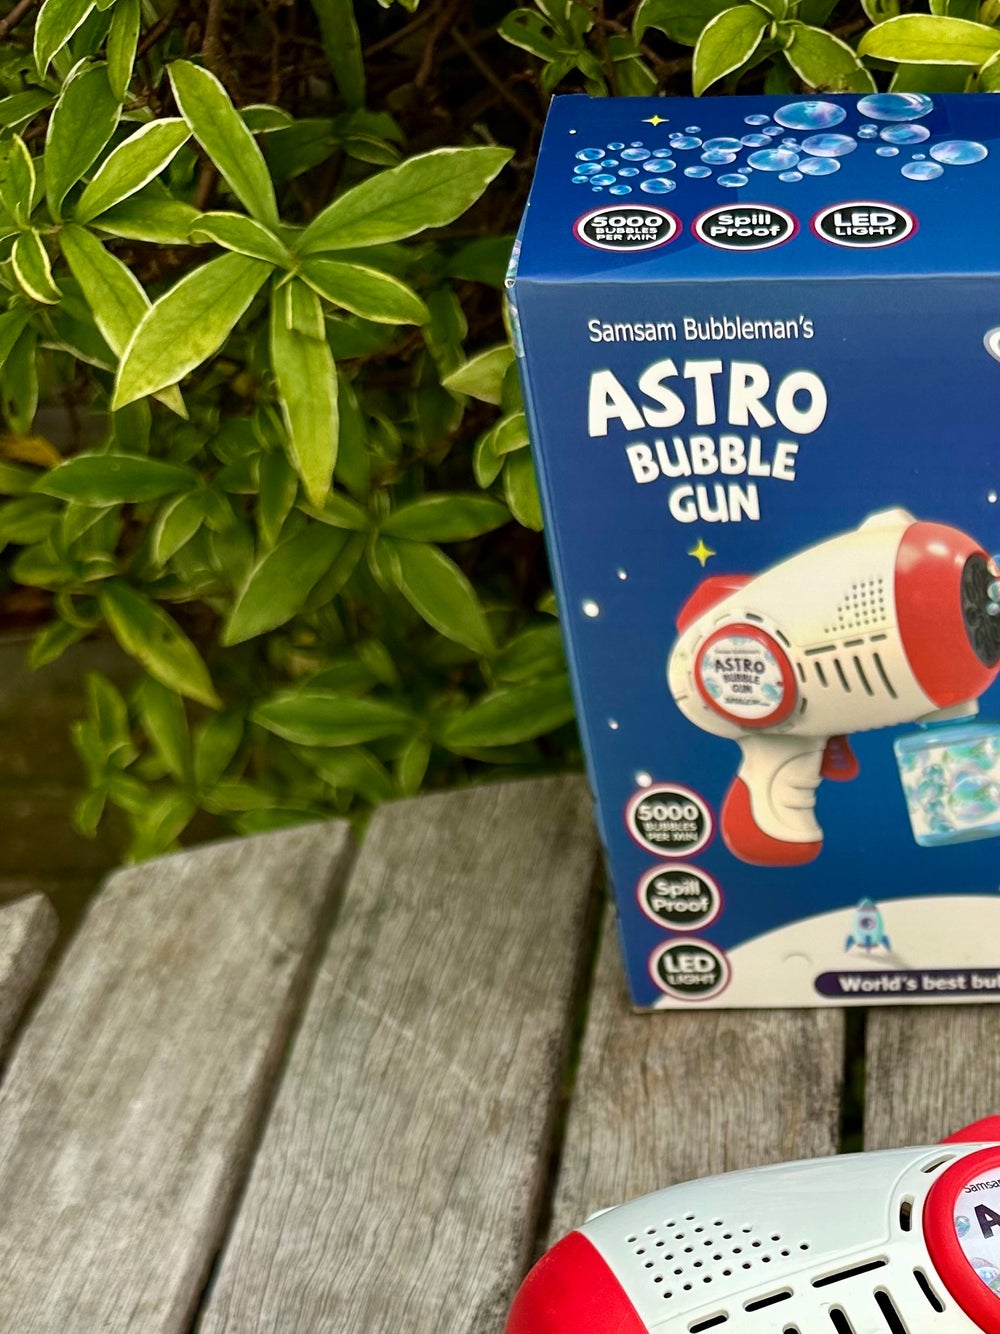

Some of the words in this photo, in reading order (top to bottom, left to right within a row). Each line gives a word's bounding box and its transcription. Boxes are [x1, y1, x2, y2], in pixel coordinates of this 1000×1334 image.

[590, 216, 663, 228] 5000
[718, 214, 772, 228] Spill
[833, 213, 897, 227] LED
[595, 227, 659, 235] BUBBLES
[710, 225, 781, 238] Proof
[835, 226, 897, 237] LIGHT
[588, 317, 678, 343] Samsam
[683, 315, 815, 341] Bubbleman's
[588, 358, 829, 438] ASTRO
[625, 435, 800, 485] BUBBLE
[667, 483, 761, 524] GUN
[714, 657, 766, 675] ASTRO
[637, 804, 700, 822] 5000
[645, 831, 672, 842] PER
[655, 880, 701, 899] Spill
[652, 897, 709, 913] Proof
[663, 953, 716, 974] LED
[665, 973, 717, 986] LIGHT
[838, 975, 918, 993] World's
[921, 974, 966, 992] best
